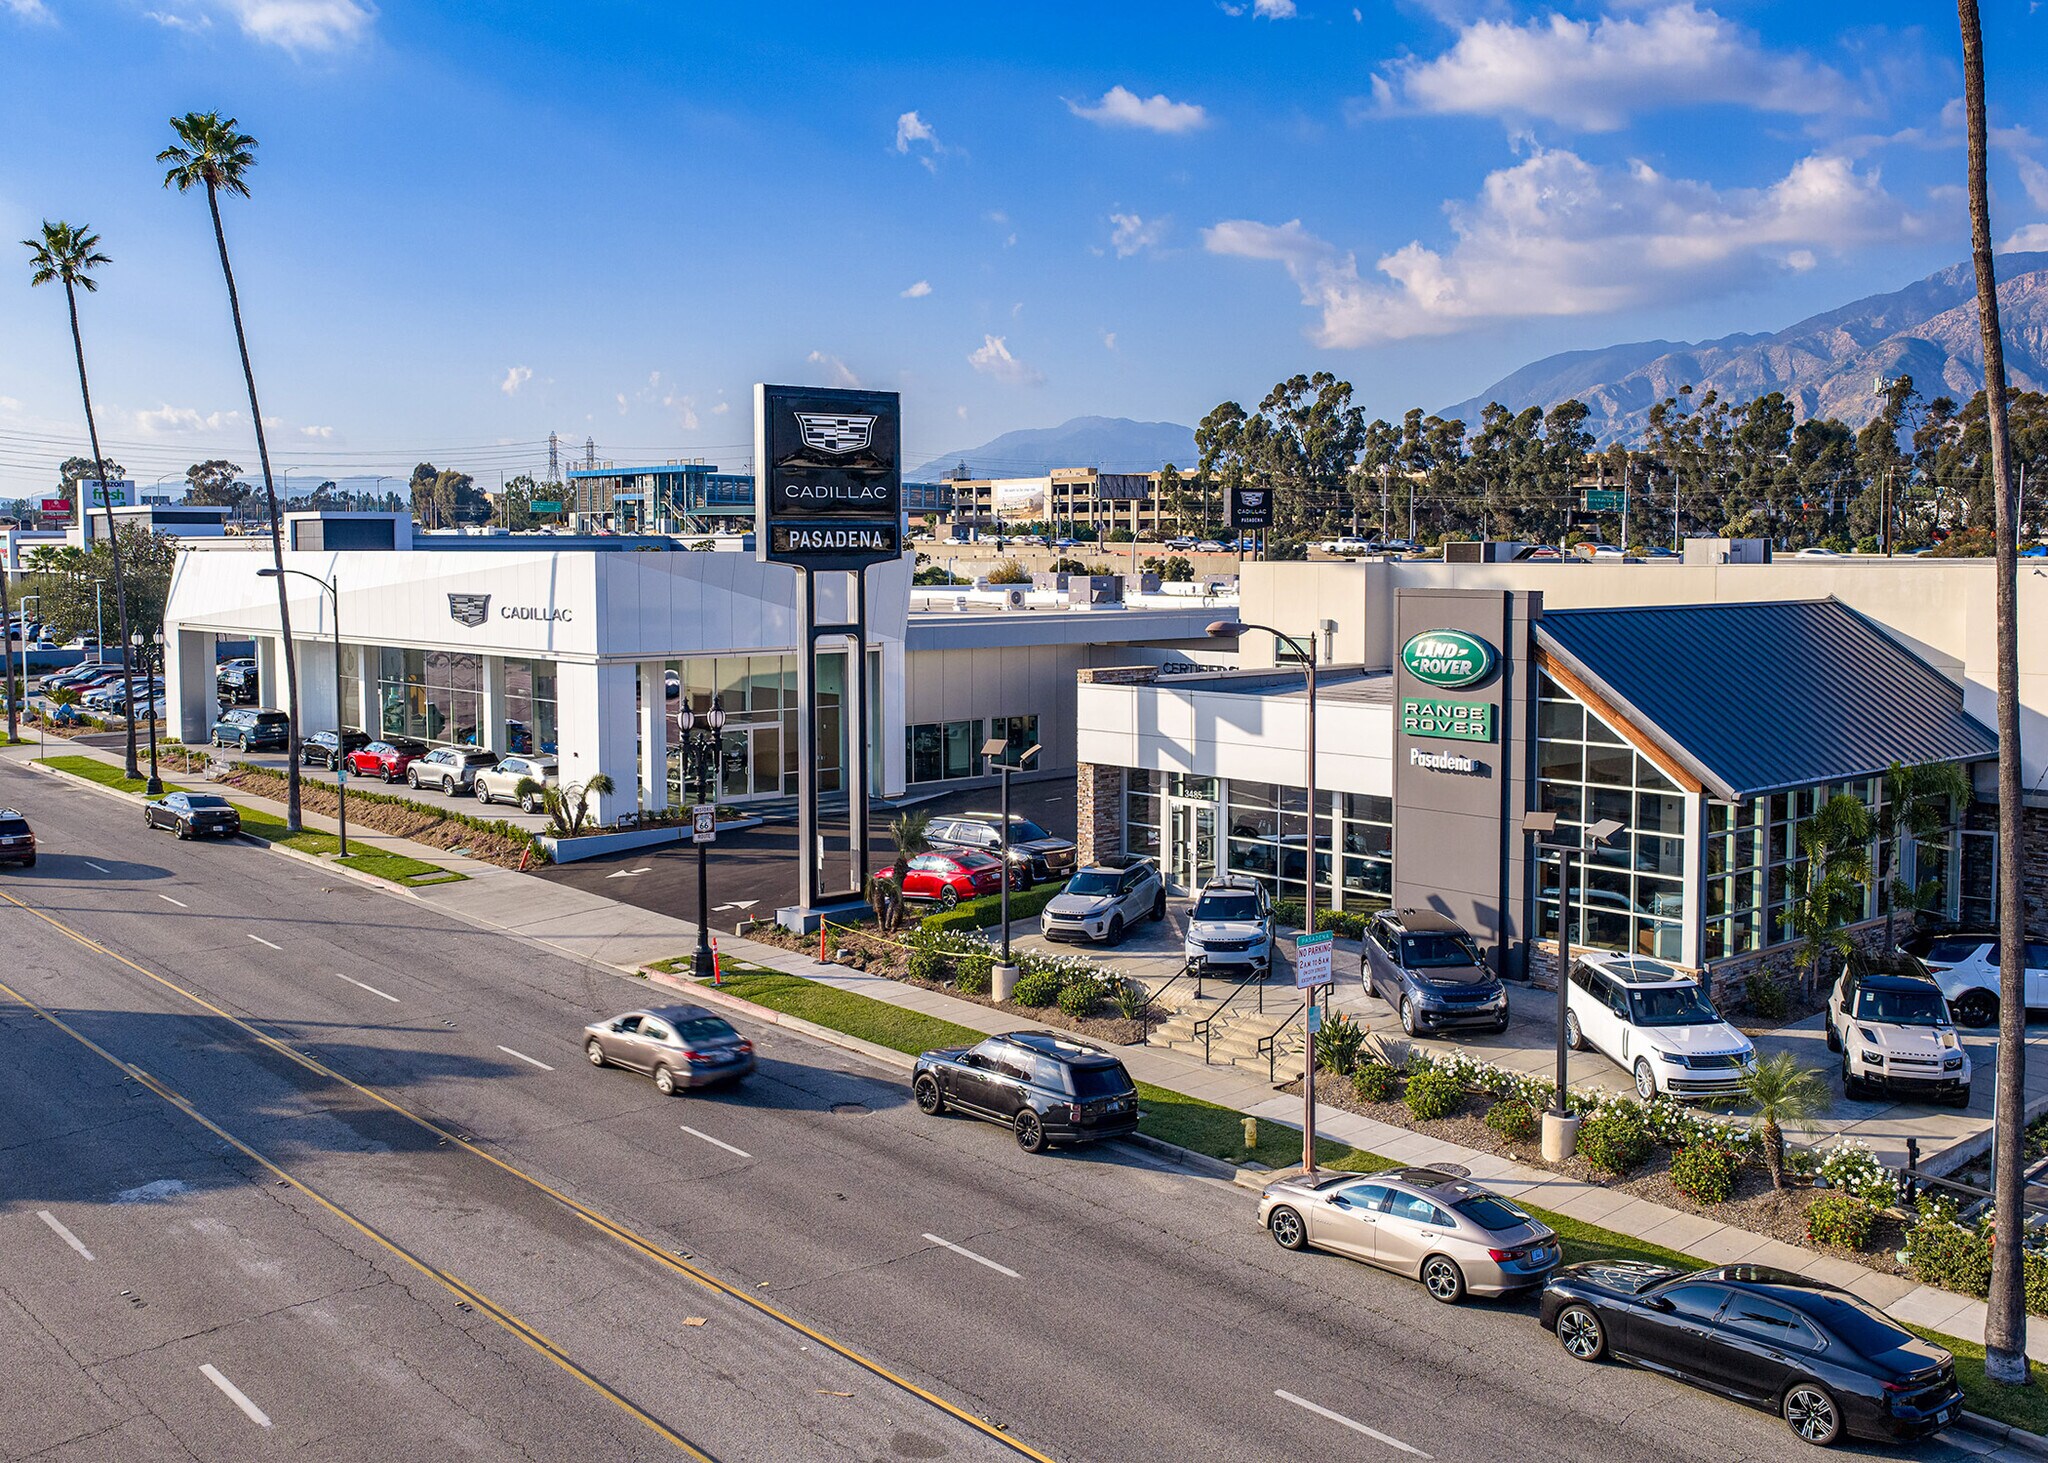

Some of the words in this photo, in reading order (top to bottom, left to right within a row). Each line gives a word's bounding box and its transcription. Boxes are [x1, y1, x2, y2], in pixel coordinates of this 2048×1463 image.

[92, 488, 125, 500] frsh
[785, 485, 887, 499] CADILLAC
[789, 530, 883, 549] PASADENA
[501, 606, 573, 623] CADILLAC
[1415, 641, 1458, 659] LAND
[1419, 659, 1473, 676] ROVER
[1404, 702, 1486, 721] RANGE
[1404, 717, 1486, 736] ROVER
[1410, 747, 1474, 773] Pasadena
[1184, 789, 1203, 800] 3485
[699, 821, 709, 830] 66
[1301, 933, 1330, 944] PASADENA
[1299, 948, 1308, 958] NO
[1308, 943, 1332, 956] PARKING
[1890, 1050, 1938, 1058] DEFENDER
